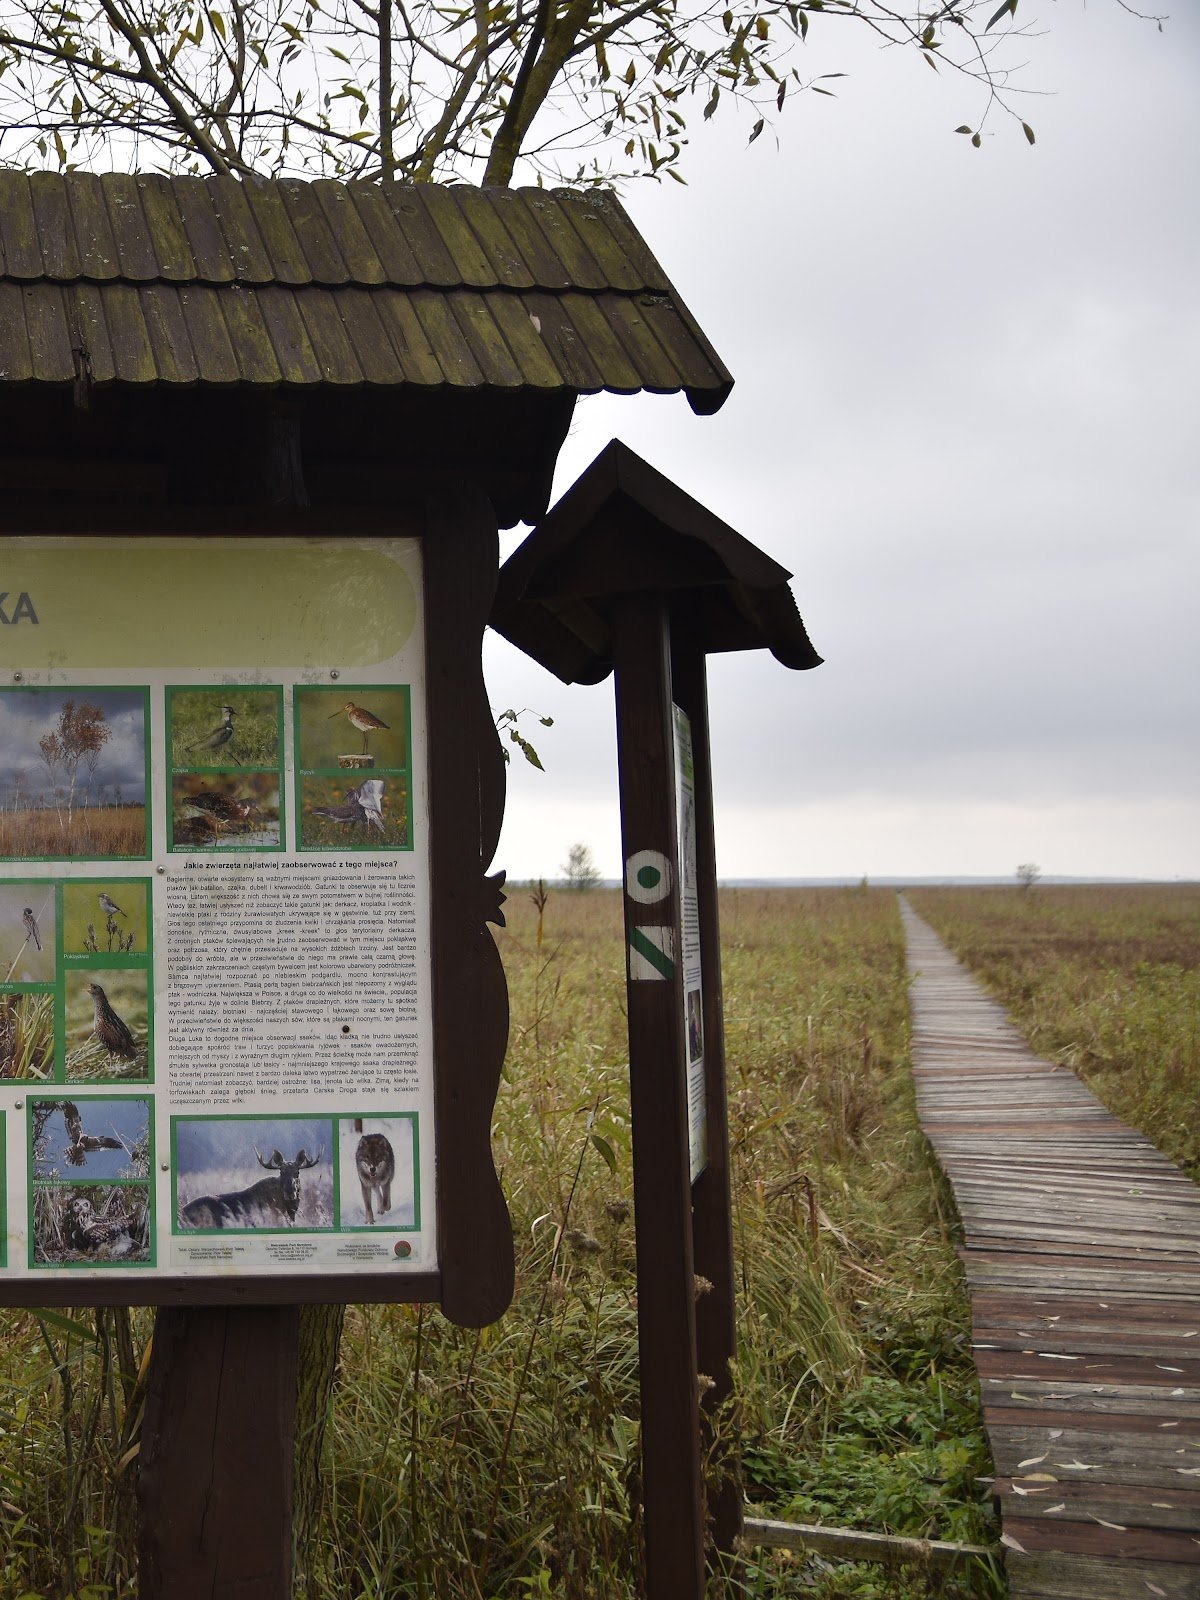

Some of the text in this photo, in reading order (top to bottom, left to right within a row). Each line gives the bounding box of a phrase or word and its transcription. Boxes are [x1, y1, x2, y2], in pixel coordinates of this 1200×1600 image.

[204, 861, 243, 870] zwierzęta
[242, 861, 279, 870] najłatwiej
[280, 860, 337, 868] zaobserwować
[345, 860, 362, 869] tego
[364, 860, 398, 869] miejsca?
